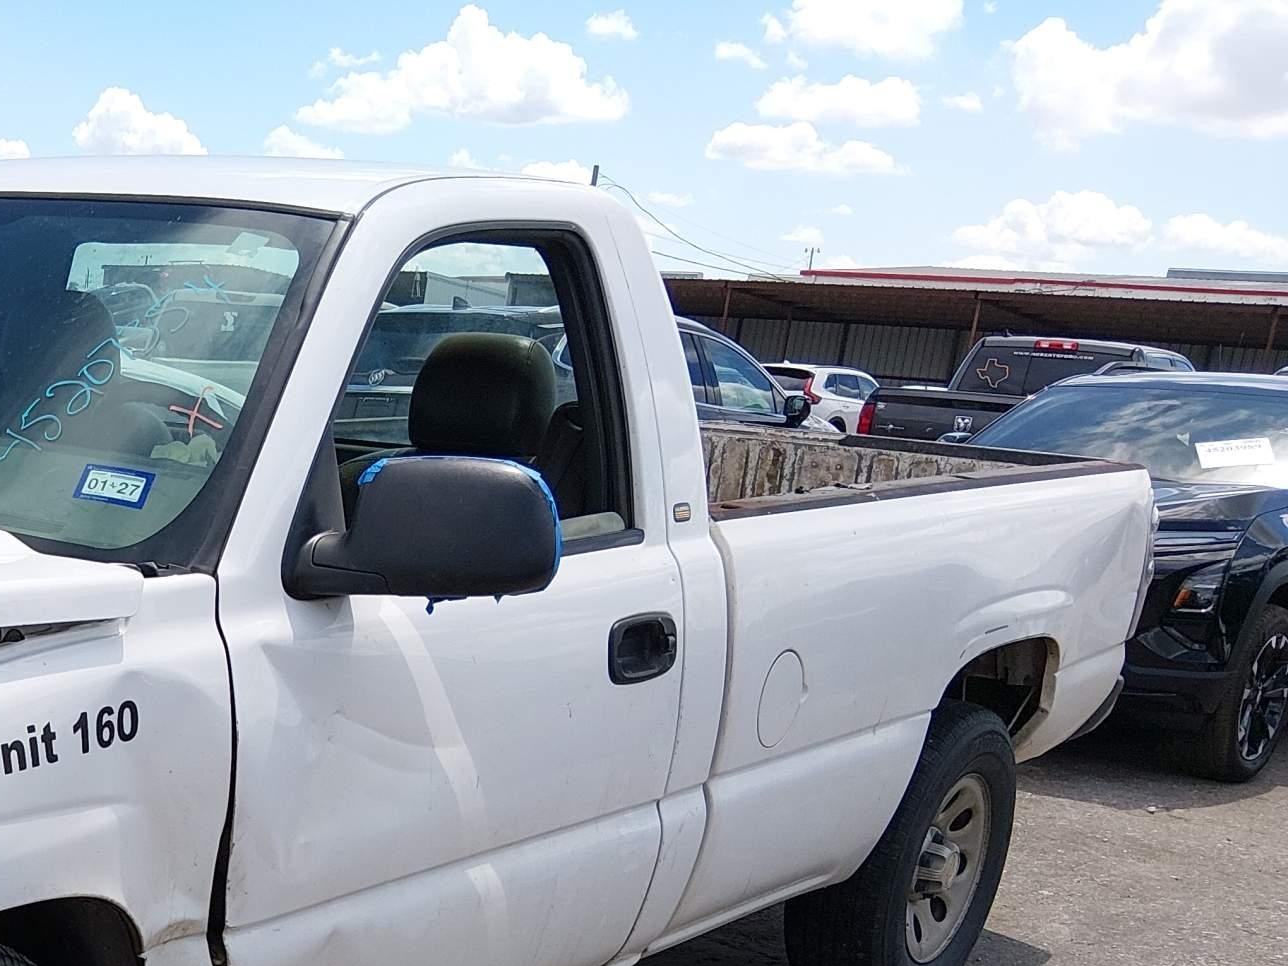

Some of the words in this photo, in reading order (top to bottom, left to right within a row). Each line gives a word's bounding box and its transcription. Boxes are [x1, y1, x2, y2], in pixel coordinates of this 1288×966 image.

[87, 478, 108, 491] 01
[116, 482, 141, 496] 27
[72, 700, 139, 754] 160
